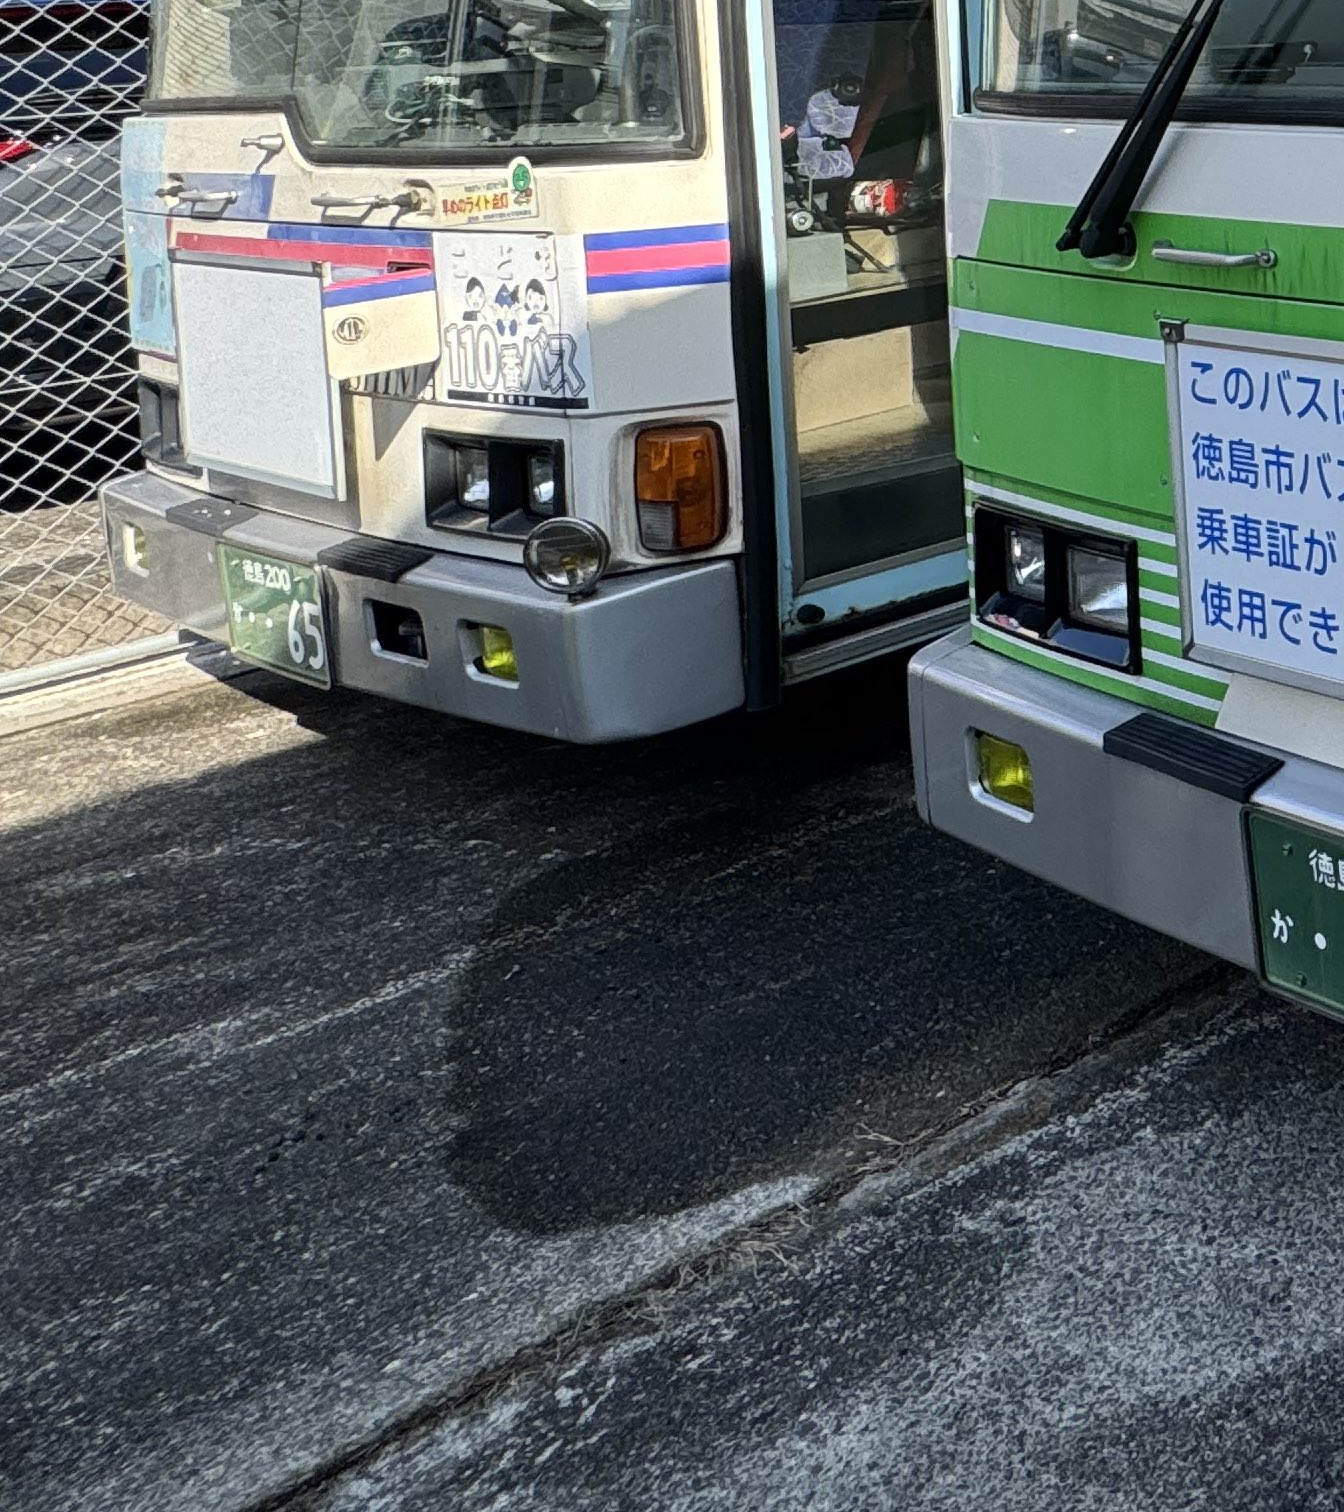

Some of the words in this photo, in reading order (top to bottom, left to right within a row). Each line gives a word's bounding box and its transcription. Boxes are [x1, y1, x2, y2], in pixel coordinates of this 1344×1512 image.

[1196, 506, 1337, 576] 乗車証が
[288, 599, 325, 670] 65
[1271, 908, 1294, 944] か
